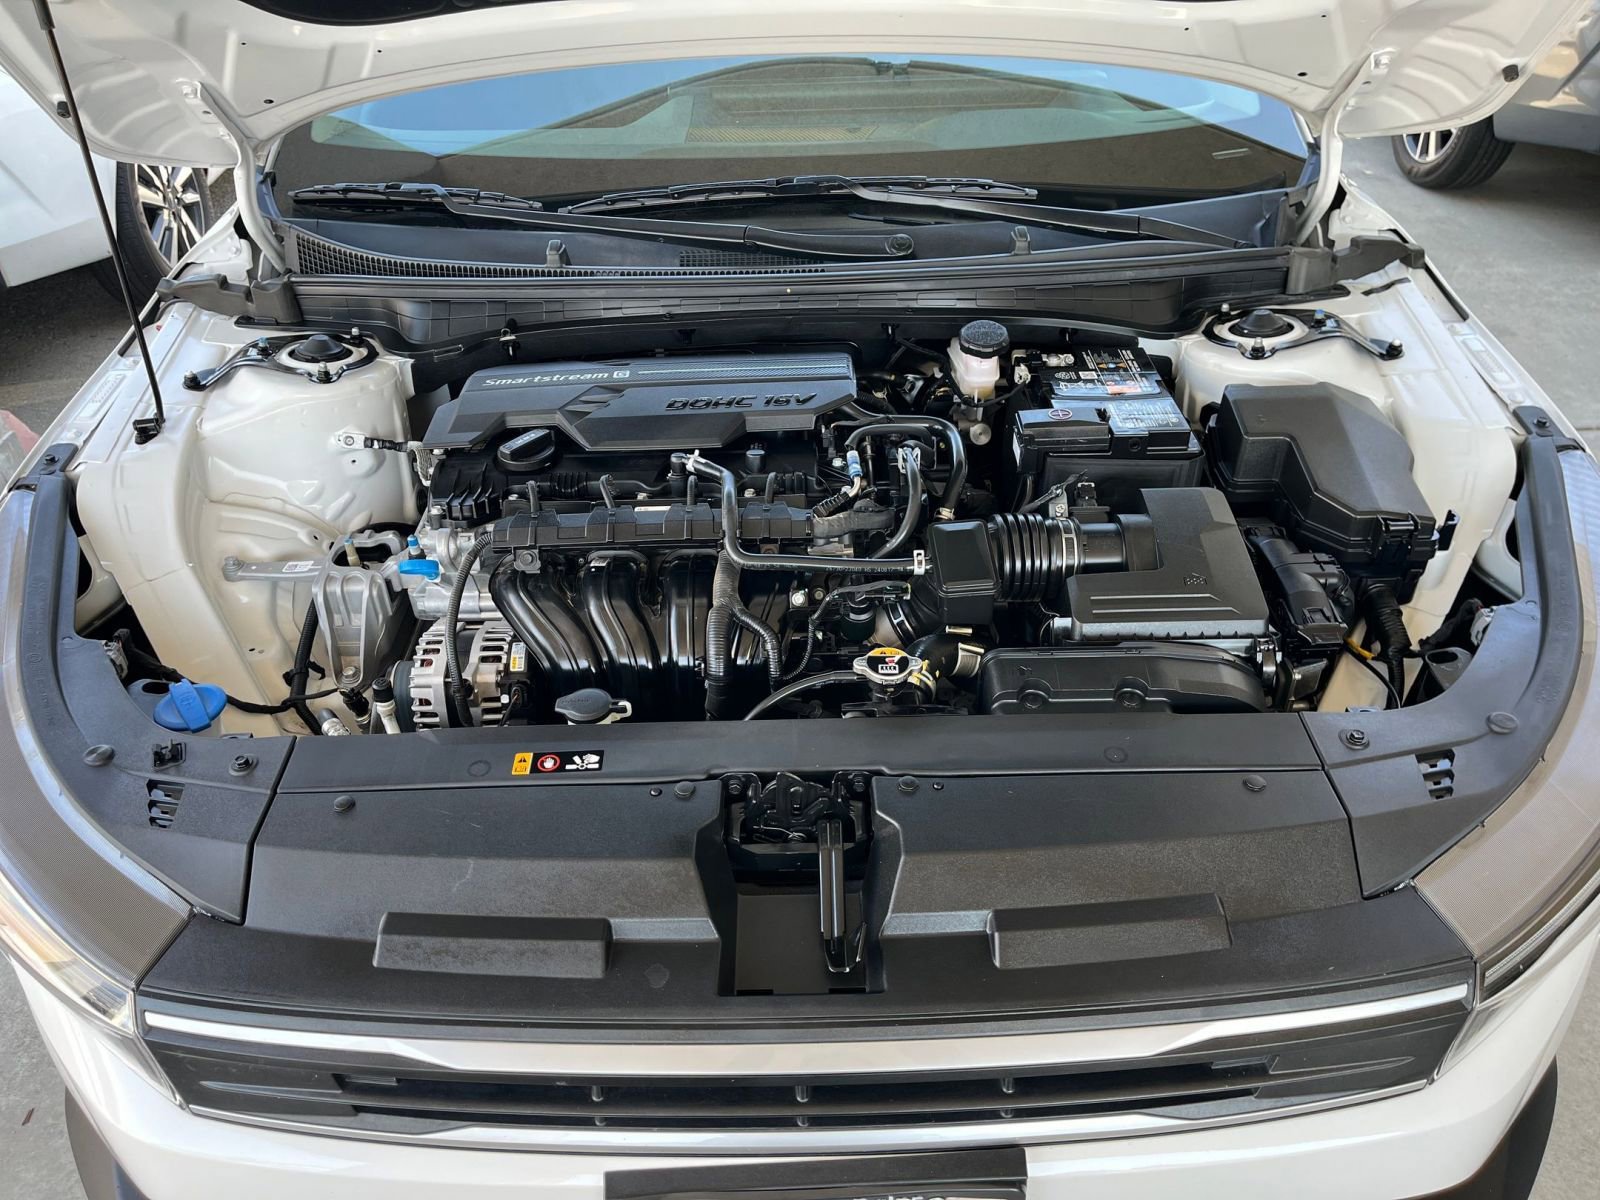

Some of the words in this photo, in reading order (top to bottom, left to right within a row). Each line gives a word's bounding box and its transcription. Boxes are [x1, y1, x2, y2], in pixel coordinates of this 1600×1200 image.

[482, 372, 608, 386] Smartstream
[665, 395, 758, 411] DOHC
[763, 393, 818, 407] 16V
